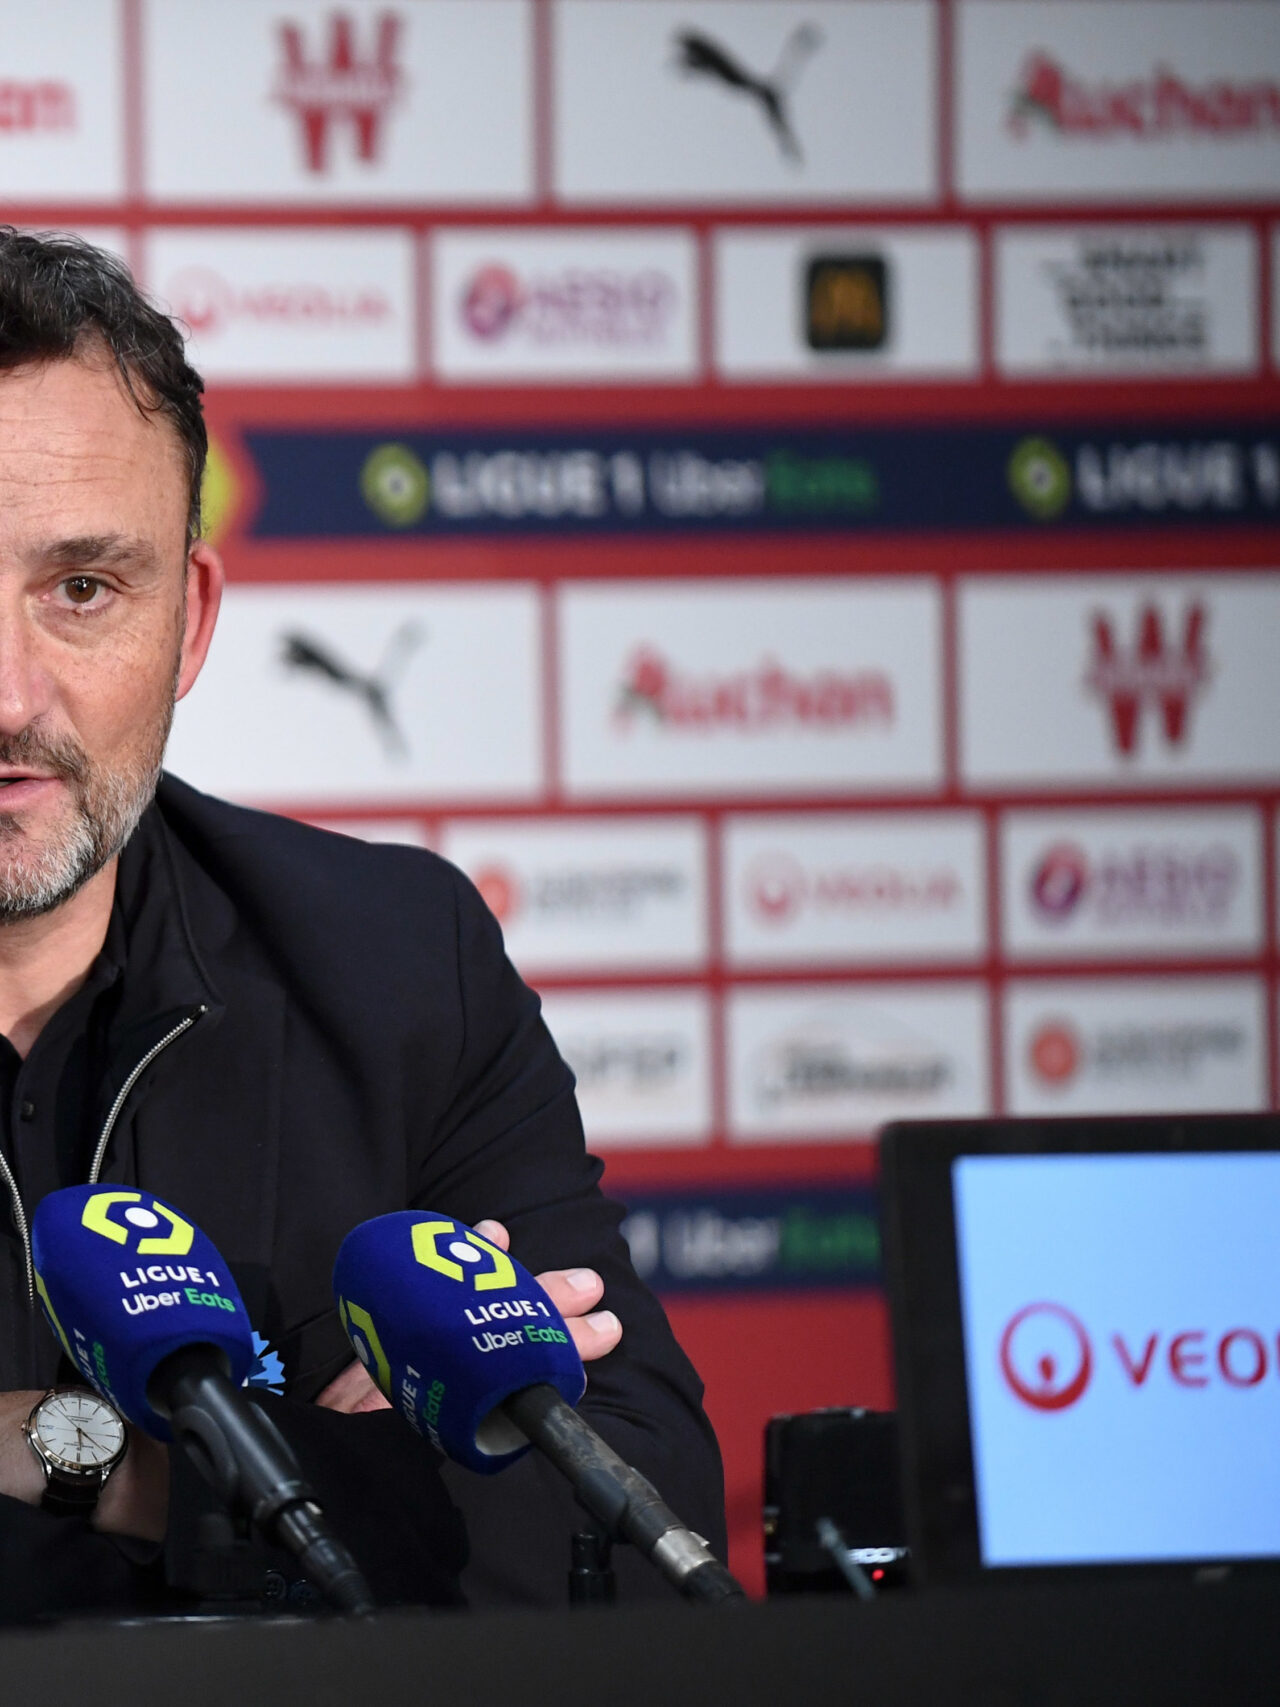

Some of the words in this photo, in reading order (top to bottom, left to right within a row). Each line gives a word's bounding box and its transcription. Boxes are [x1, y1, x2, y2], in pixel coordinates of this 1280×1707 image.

[432, 450, 606, 517] LIGUE
[612, 450, 643, 518] 1
[650, 450, 763, 516] Uber
[766, 449, 875, 513] Eats
[1077, 440, 1239, 511] LIGUE
[666, 1211, 780, 1278] Uber
[120, 1266, 205, 1289] LIGUE
[206, 1272, 220, 1287] 1
[122, 1291, 181, 1316] Uber
[184, 1287, 236, 1312] Eats
[464, 1300, 538, 1325] LIGUE
[536, 1301, 551, 1317] 1
[472, 1330, 524, 1352] Uber
[523, 1325, 569, 1344] Eats
[1111, 1329, 1280, 1389] VEO
[423, 1380, 445, 1426] Eats
